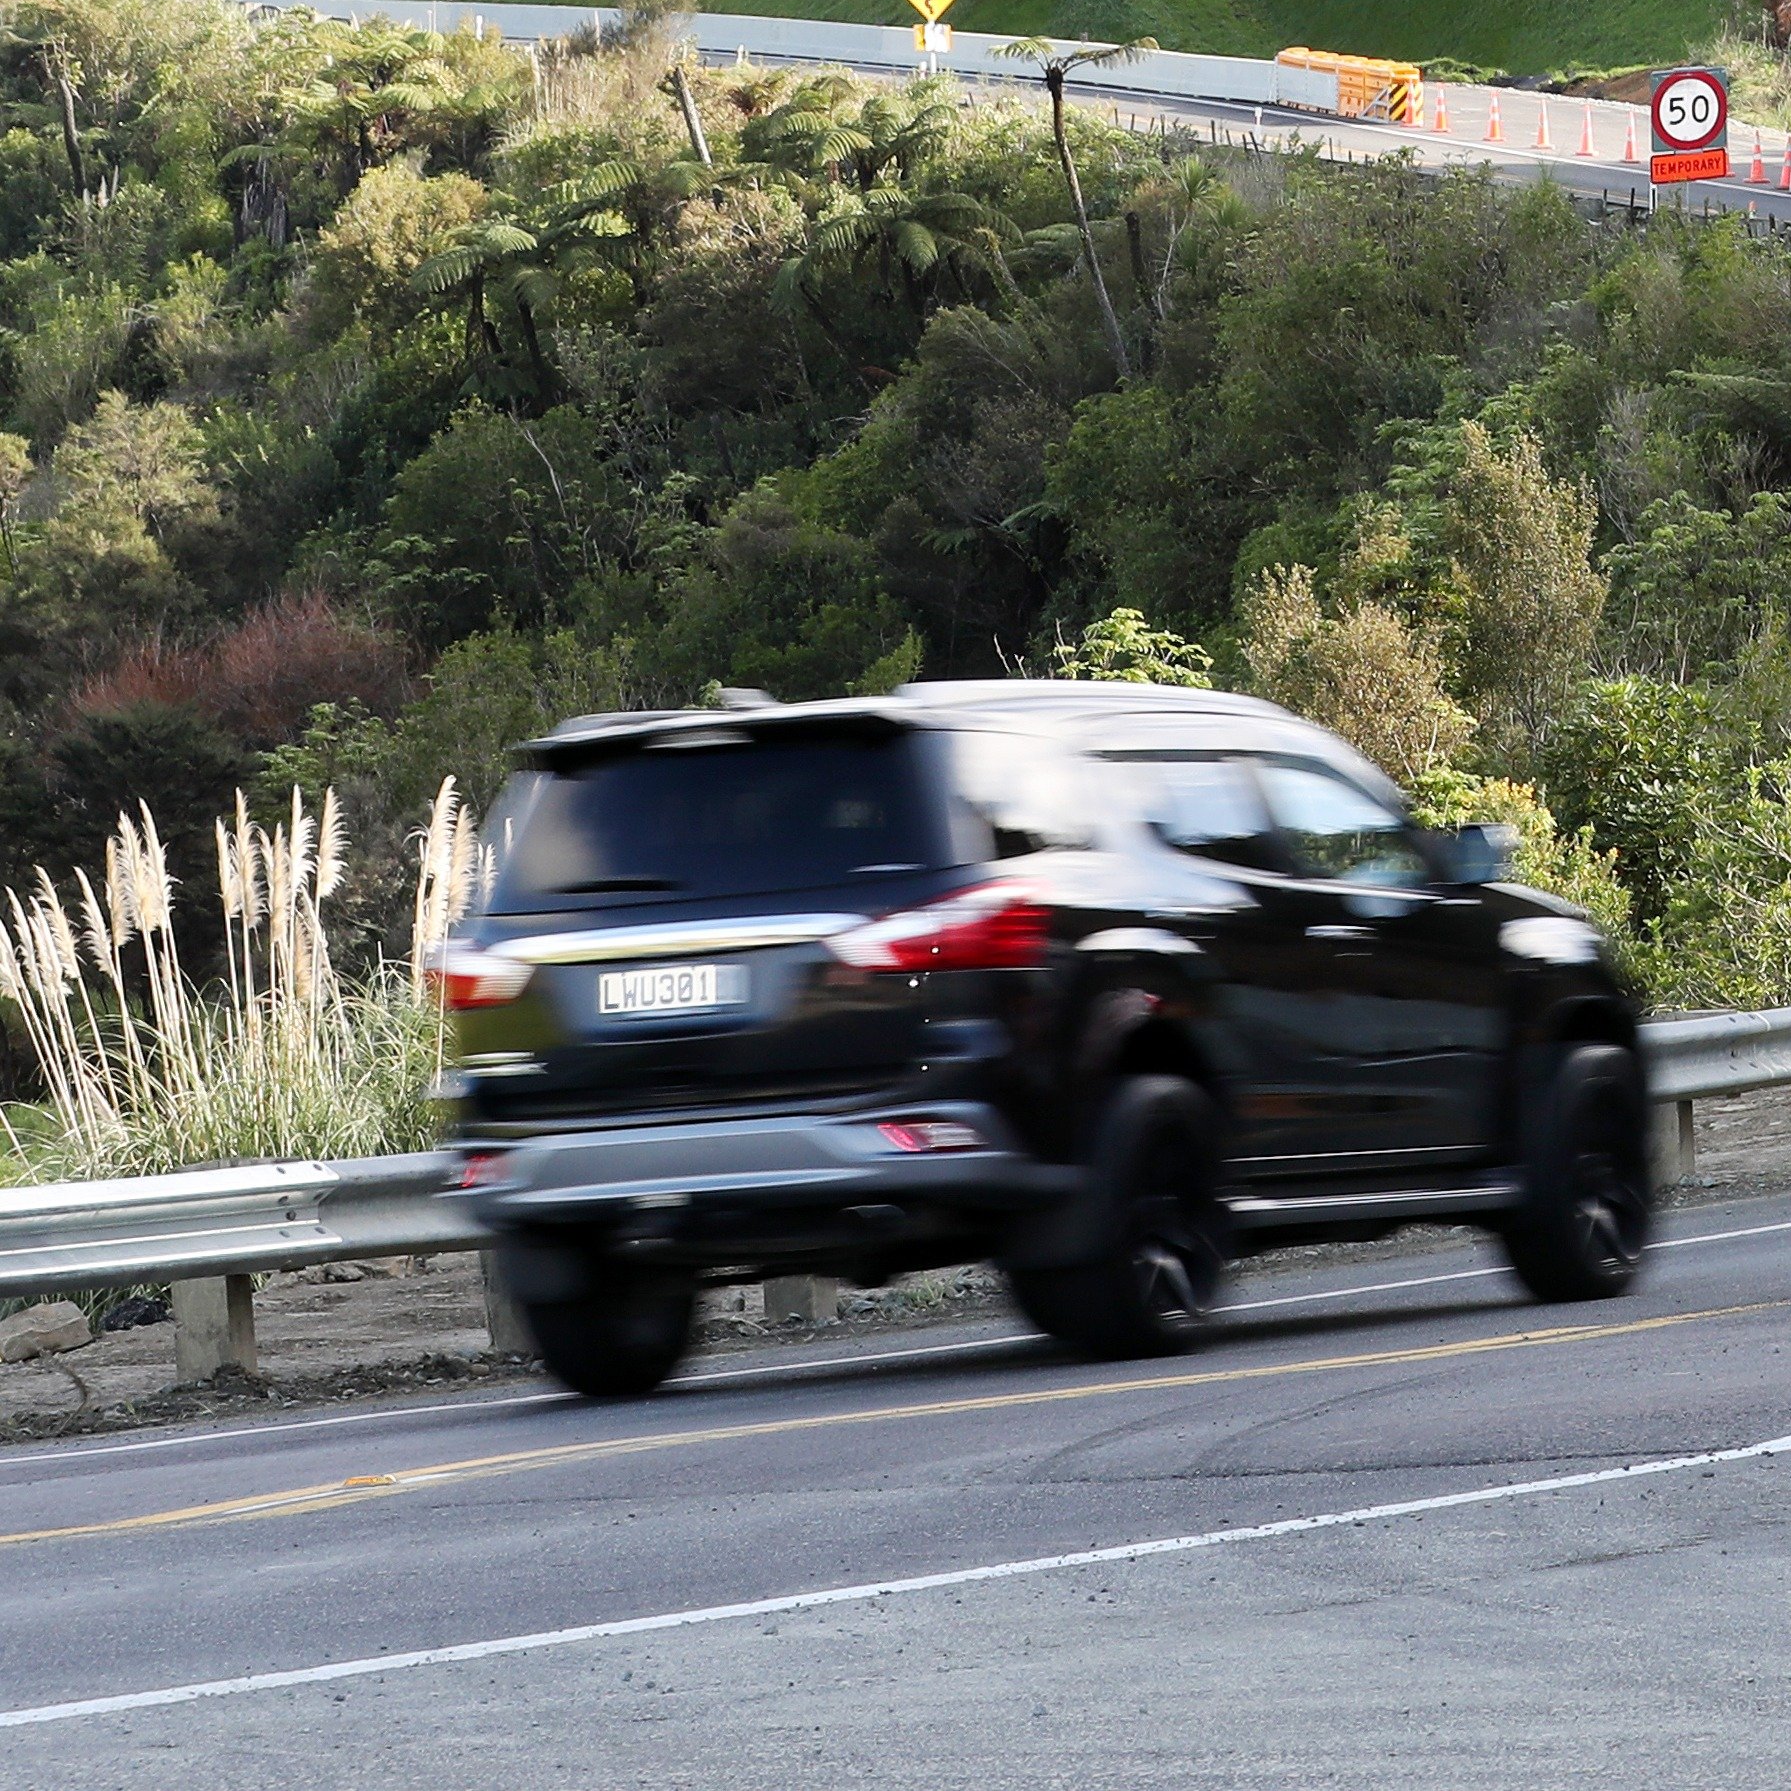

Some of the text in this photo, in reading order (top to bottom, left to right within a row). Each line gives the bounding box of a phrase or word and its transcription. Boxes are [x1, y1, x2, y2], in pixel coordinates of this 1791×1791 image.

[1669, 95, 1709, 125] 50
[1654, 157, 1722, 175] TEMPORARY
[604, 971, 708, 1009] LWU301
